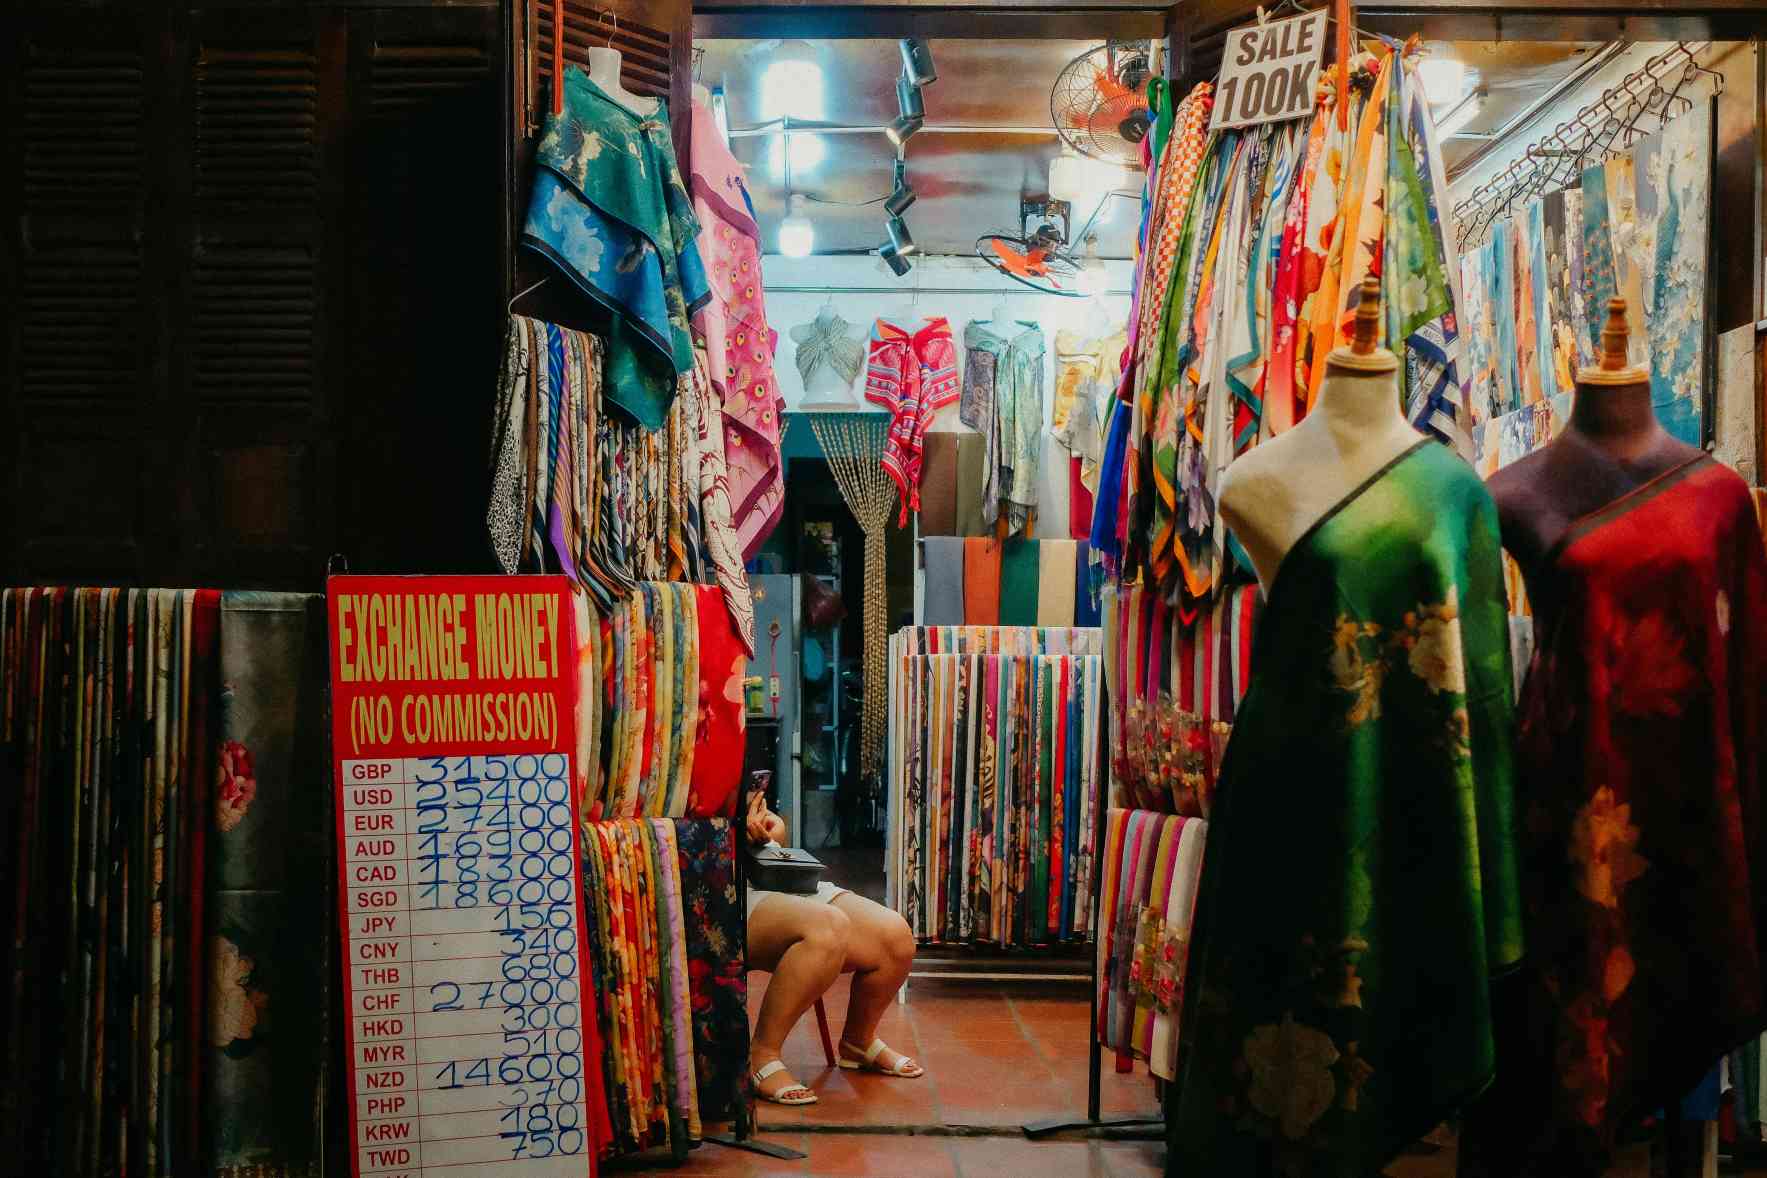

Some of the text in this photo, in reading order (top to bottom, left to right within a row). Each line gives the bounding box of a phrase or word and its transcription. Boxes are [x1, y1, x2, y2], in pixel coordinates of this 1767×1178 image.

[1236, 16, 1316, 67] SALE
[1221, 60, 1317, 123] 100K
[337, 593, 559, 682] EXCHANGE MONEY
[351, 692, 558, 755] (NO COMMISSION)
[352, 753, 567, 783] GBP 31500
[353, 778, 568, 809] USD 25400
[354, 803, 571, 834] EUR 27400
[355, 828, 572, 859] AUD 16900
[356, 854, 573, 884] CAD 18300
[357, 878, 572, 909] SGD 18600
[361, 902, 572, 933] JPY 156
[360, 928, 576, 959] CNY 340
[361, 952, 576, 984] THB 680
[362, 977, 578, 1012] CHF 27000
[363, 1002, 578, 1037] HKD 300
[363, 1027, 580, 1063] MYR 510
[366, 1053, 581, 1089] NZD 14600
[365, 1103, 579, 1141] KRW 180
[367, 1098, 406, 1115] PHP
[367, 1129, 583, 1168] TWD 750
